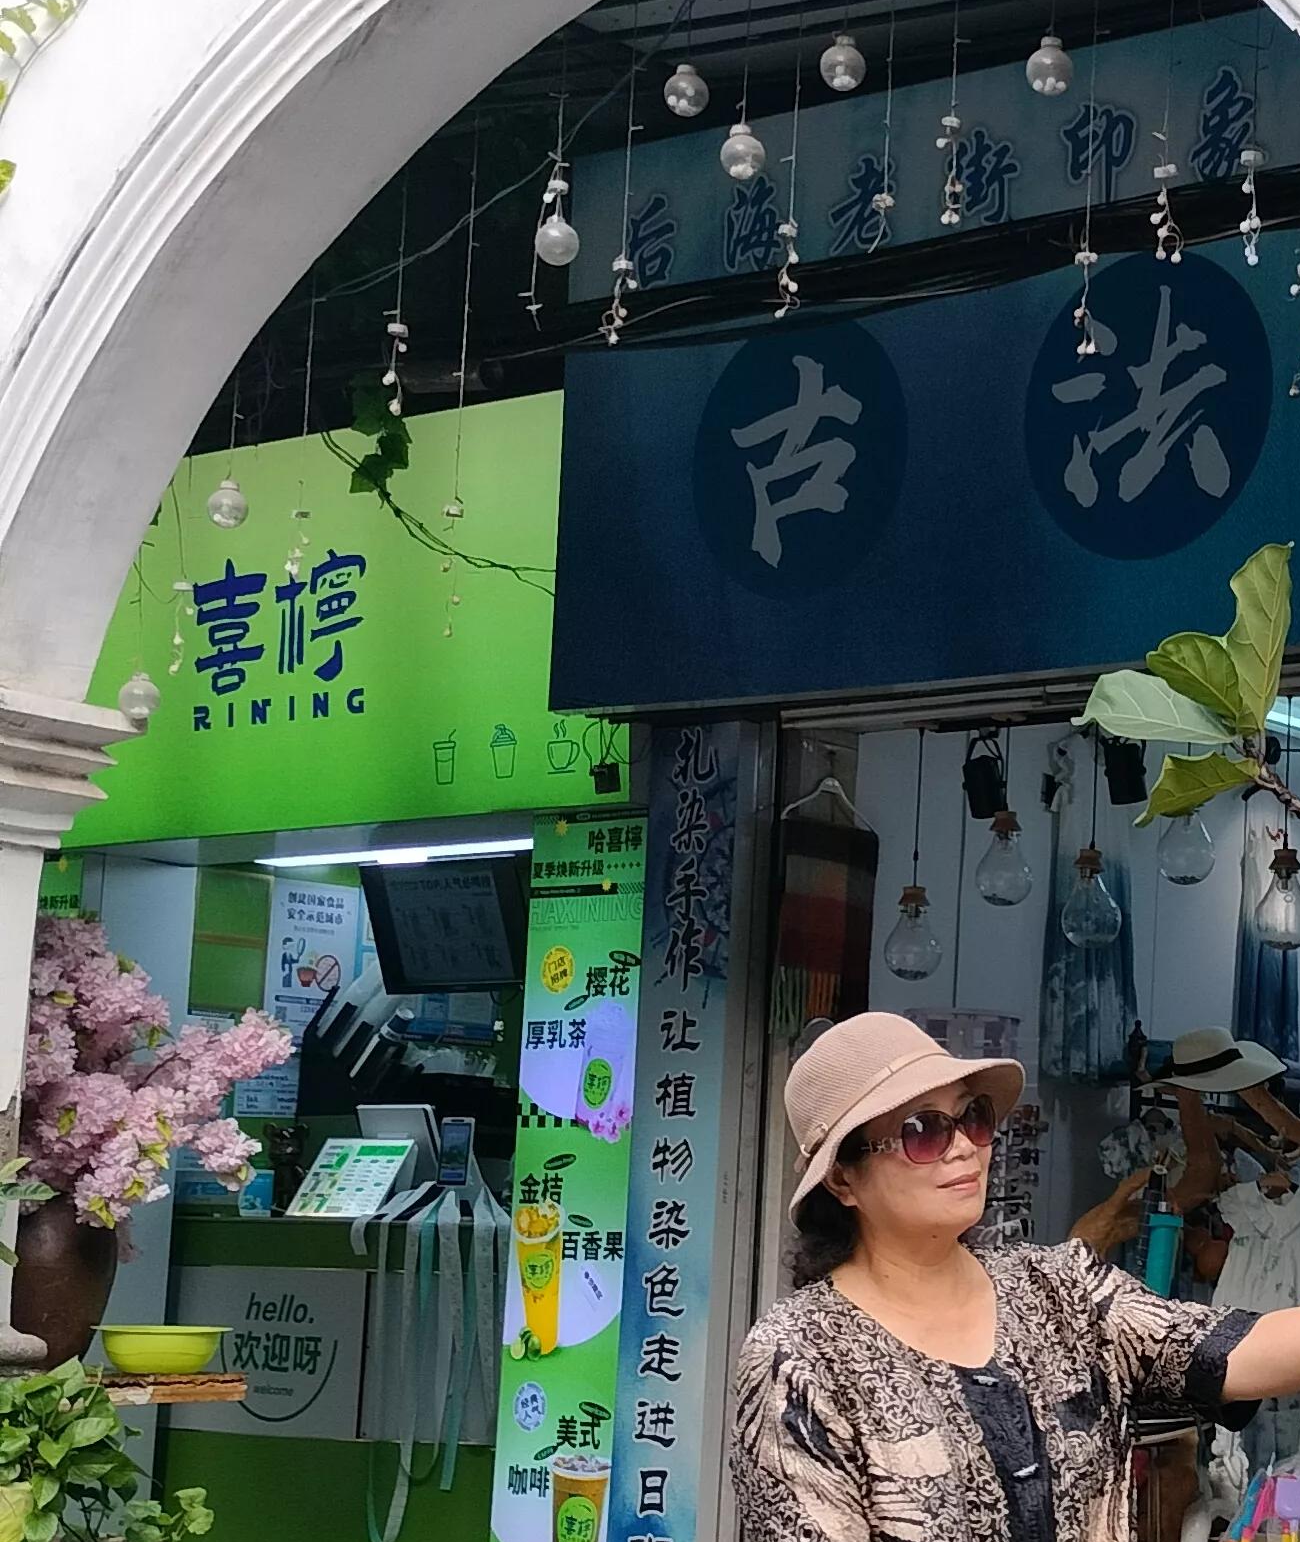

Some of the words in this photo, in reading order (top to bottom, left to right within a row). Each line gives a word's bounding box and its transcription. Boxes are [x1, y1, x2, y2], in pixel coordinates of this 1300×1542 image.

[194, 688, 365, 732] RINING
[586, 963, 630, 997] 樱花
[525, 1018, 587, 1049] 厚乳茶
[519, 1172, 564, 1206] 金桔
[561, 1230, 624, 1261] 百香果
[246, 1292, 314, 1323] hello.
[232, 1331, 322, 1375] 欢迎呀
[556, 1415, 601, 1450] 美式
[507, 1464, 550, 1497] 咖啡
